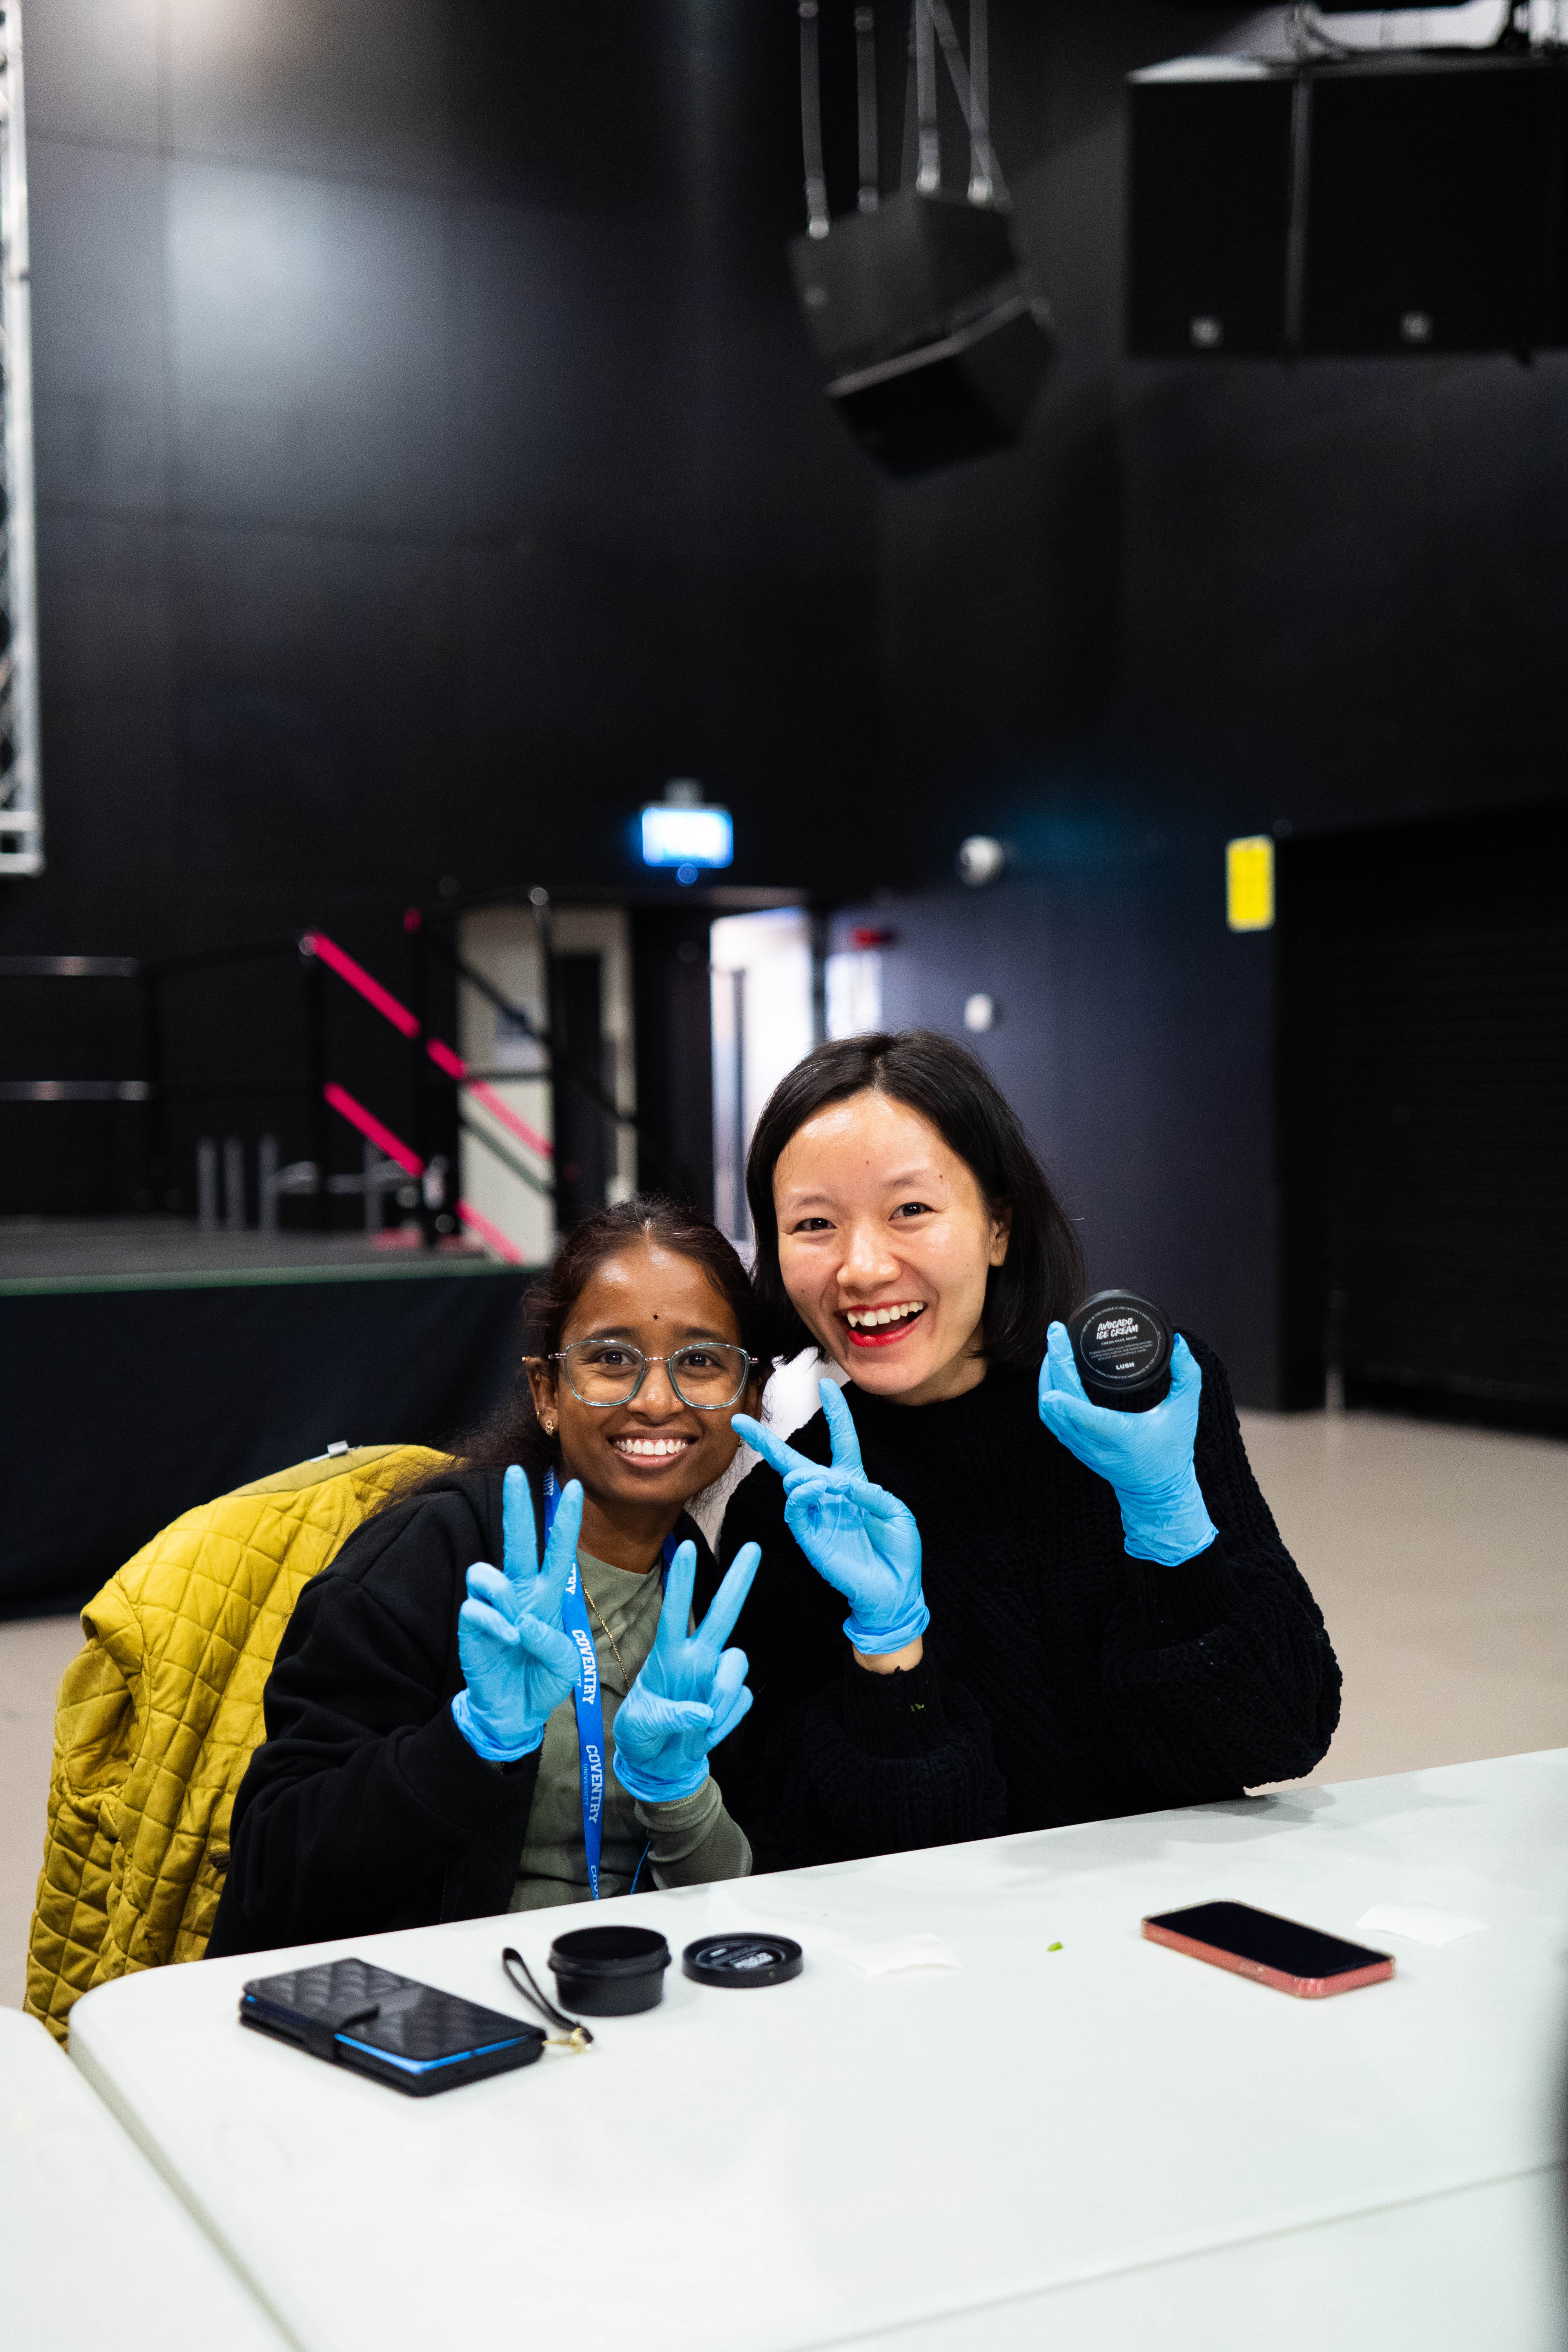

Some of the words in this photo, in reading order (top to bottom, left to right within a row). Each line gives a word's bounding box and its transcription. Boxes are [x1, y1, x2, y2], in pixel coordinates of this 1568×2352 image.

[1096, 1330, 1109, 1339] ICE
[1111, 1324, 1139, 1337] CREAM
[1097, 1318, 1133, 1332] AVOCADO
[1116, 1362, 1135, 1370] LUSH
[1127, 1368, 1145, 1378] HANDMADE
[572, 1630, 597, 1705] COVENTRY
[586, 1745, 603, 1824] COVENTRY
